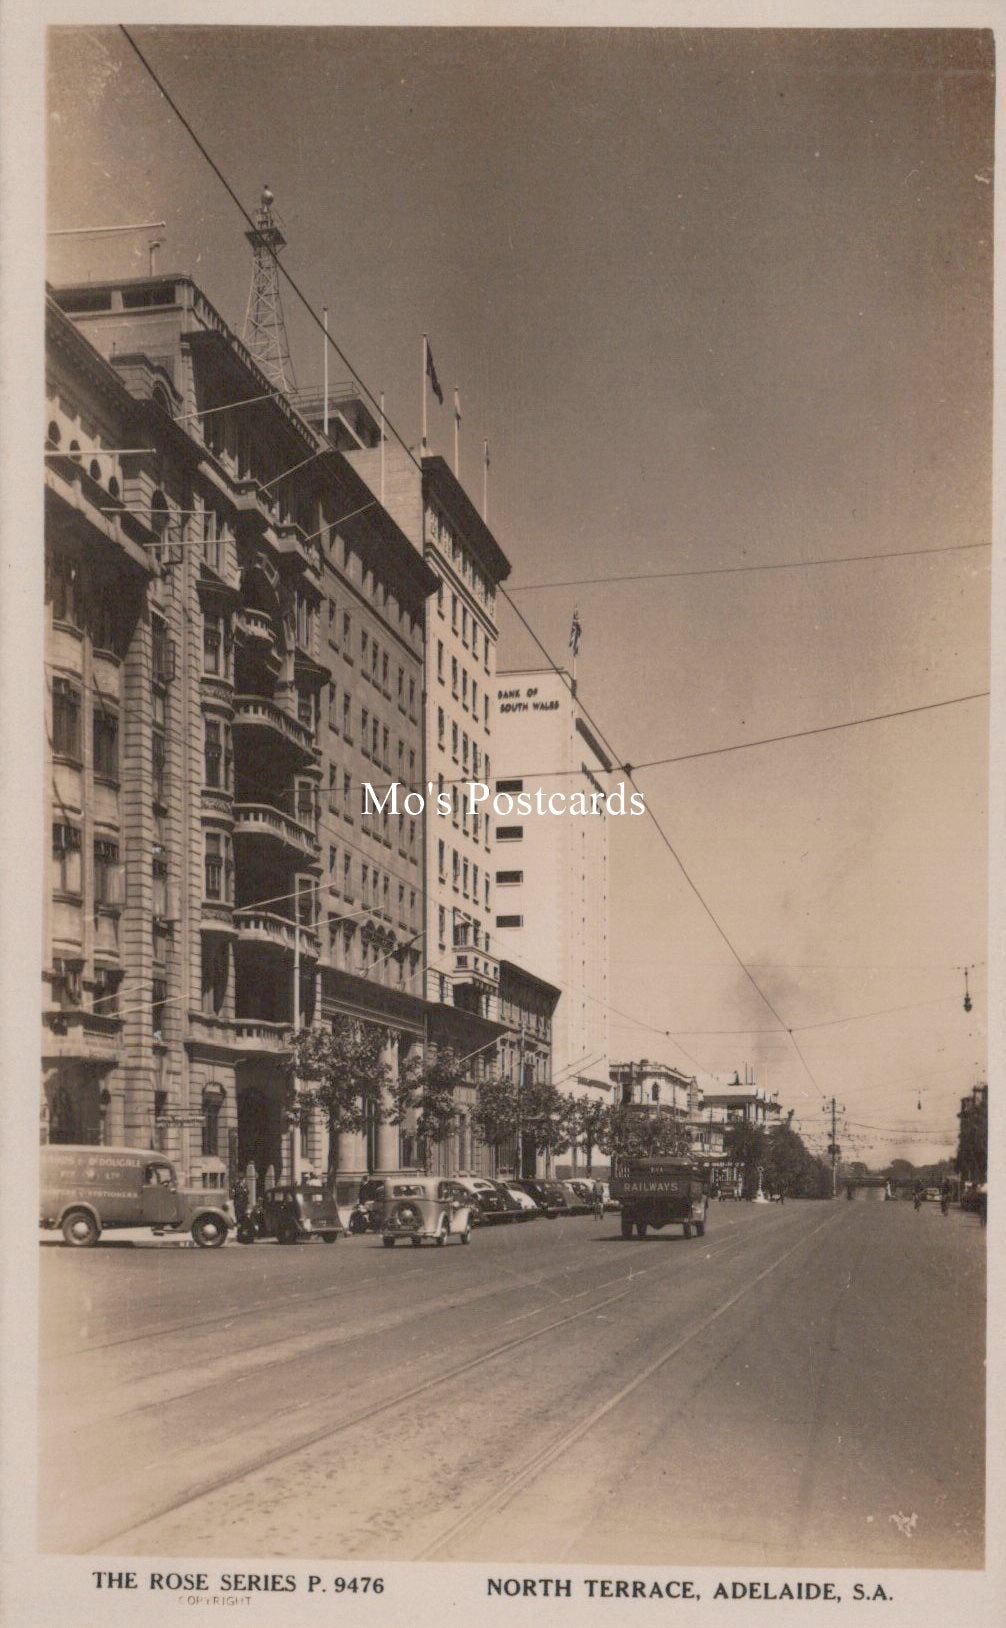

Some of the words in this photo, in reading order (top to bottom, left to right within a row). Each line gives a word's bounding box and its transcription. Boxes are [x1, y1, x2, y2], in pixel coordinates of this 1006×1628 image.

[497, 688, 520, 700] BANK
[526, 687, 539, 698] OF
[499, 702, 529, 714] SOUTH
[532, 700, 560, 711] WALES
[623, 1182, 679, 1193] RAILWAYS
